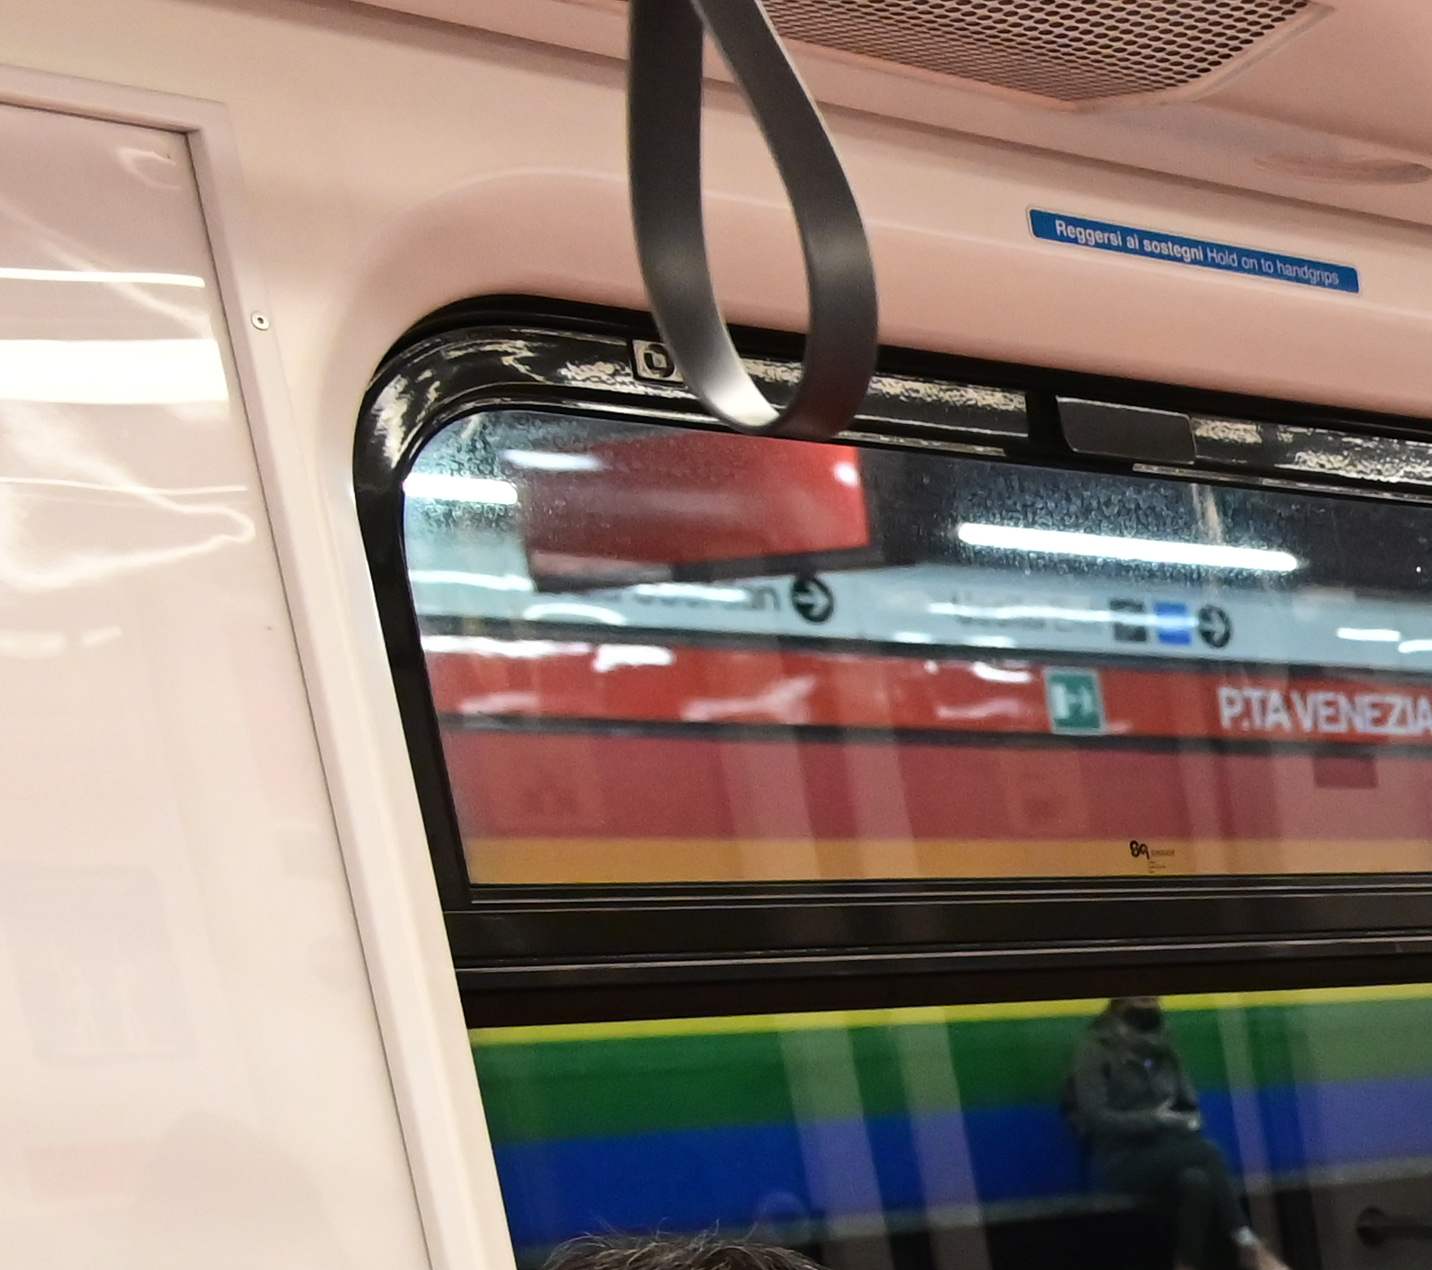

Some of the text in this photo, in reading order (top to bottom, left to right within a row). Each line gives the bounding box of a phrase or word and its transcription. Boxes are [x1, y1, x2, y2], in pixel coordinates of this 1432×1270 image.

[1055, 220, 1339, 287] Reggersi ai sostegni Hold on to handgrips
[1218, 685, 1293, 732] P.TA
